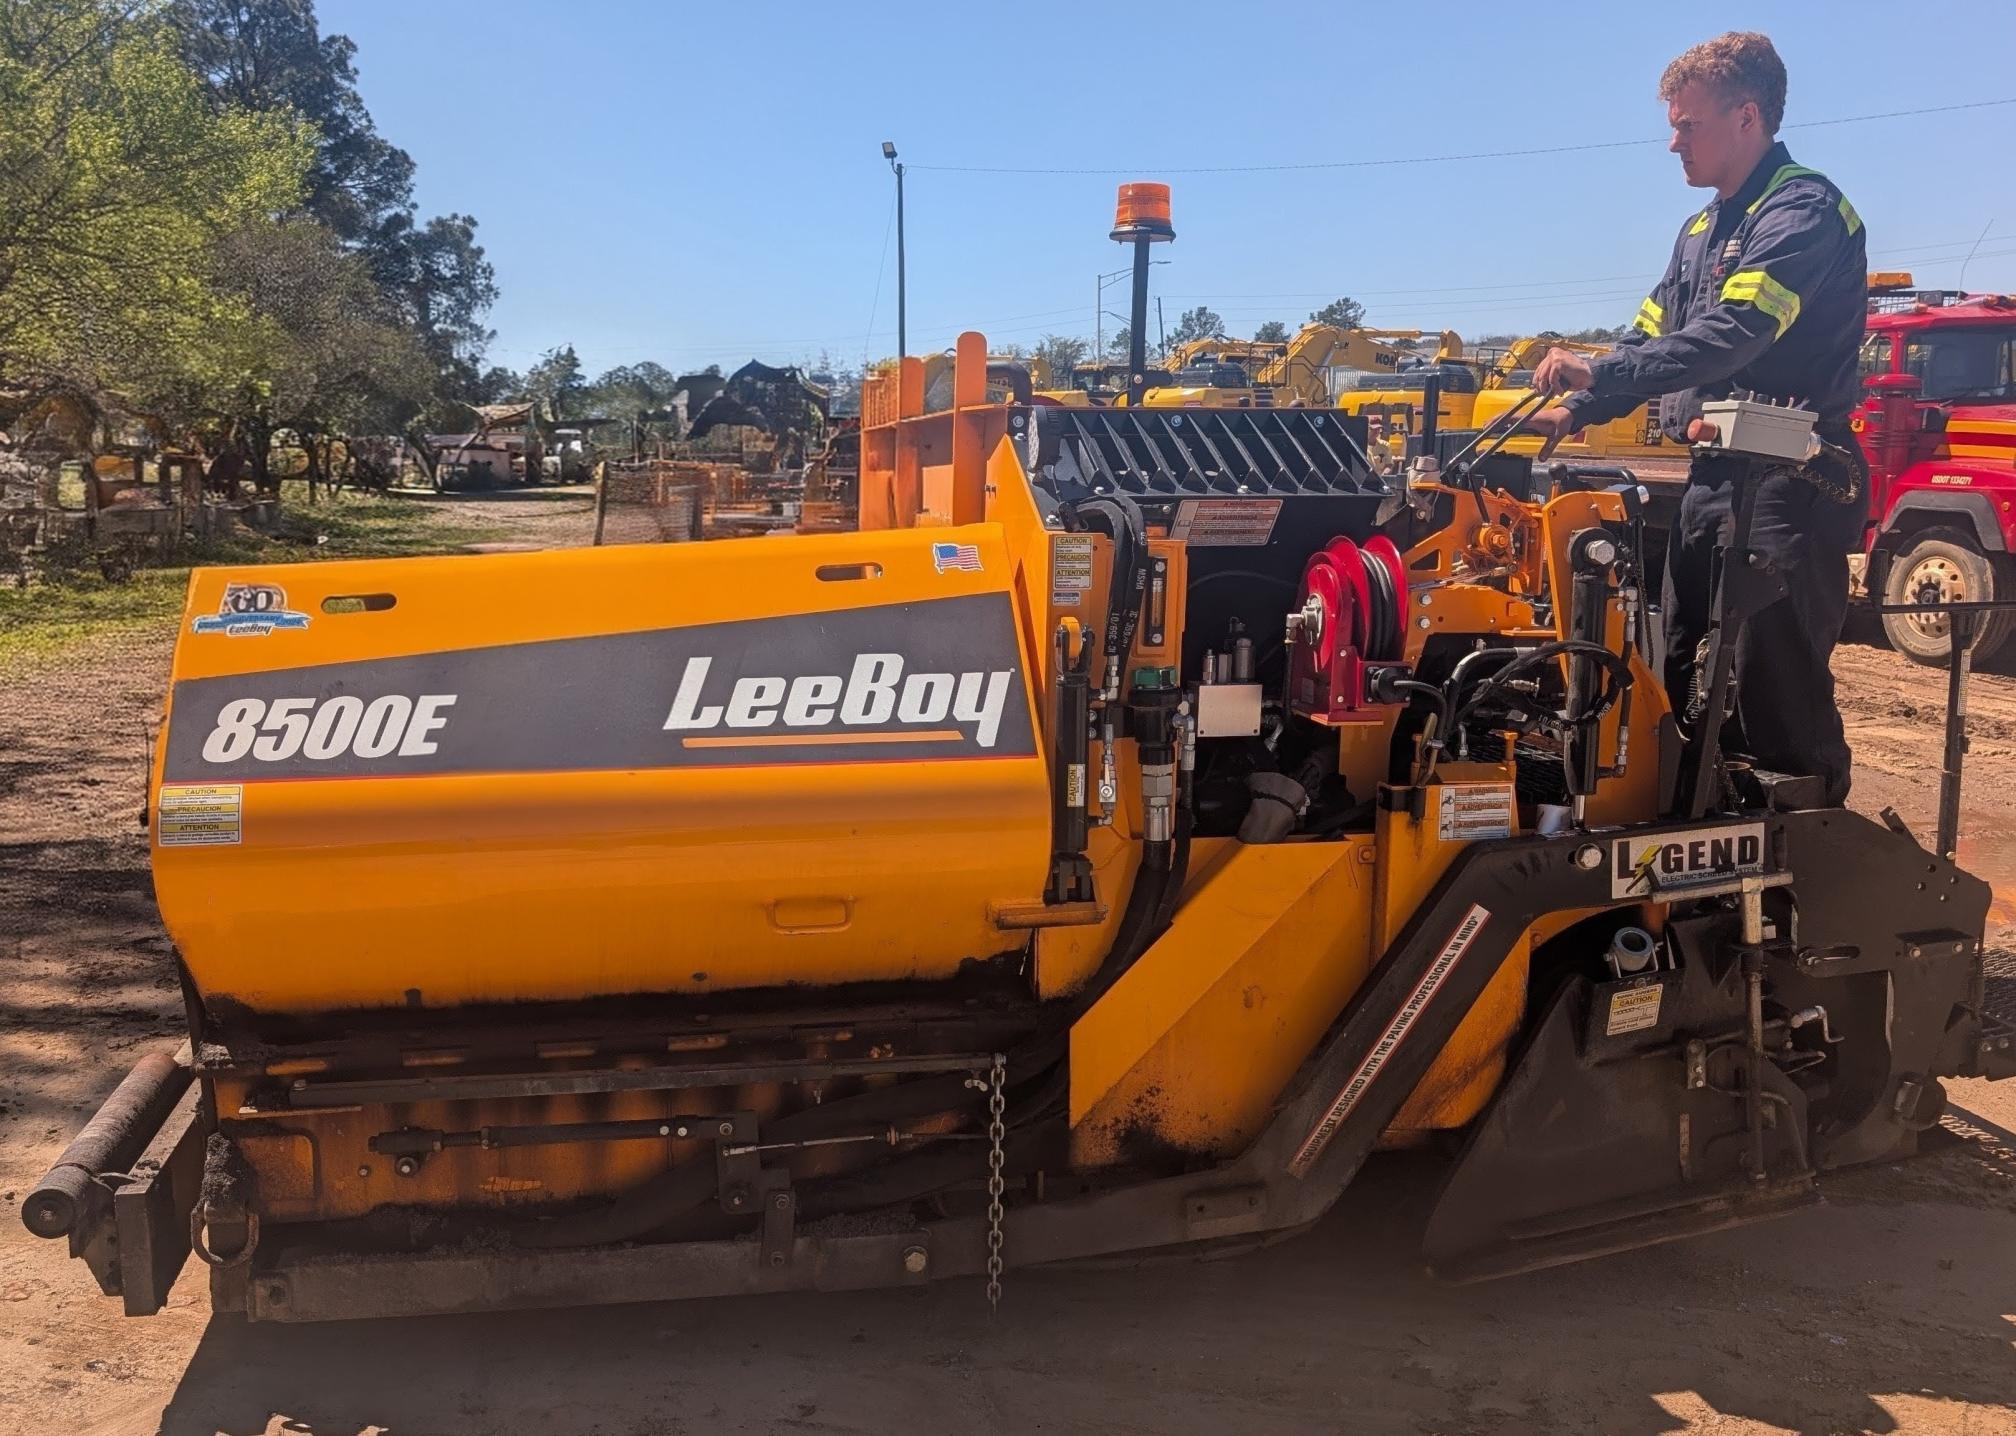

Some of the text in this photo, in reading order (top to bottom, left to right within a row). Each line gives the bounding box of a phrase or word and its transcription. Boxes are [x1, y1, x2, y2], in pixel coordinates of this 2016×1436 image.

[1647, 428, 1661, 438] 210
[663, 653, 1012, 747] LeeBoy
[202, 694, 458, 763] 8500E
[1661, 872, 1697, 883] ELECTRIC
[1620, 995, 1653, 1006] CAUTION
[1331, 1078, 1365, 1117] DESIGNED
[1361, 1057, 1382, 1077] WITH
[1374, 1040, 1393, 1059] THE
[1387, 1010, 1413, 1040] PAVING
[1408, 953, 1456, 1011] PROFESSIONAL
[1449, 941, 1463, 951] IN
